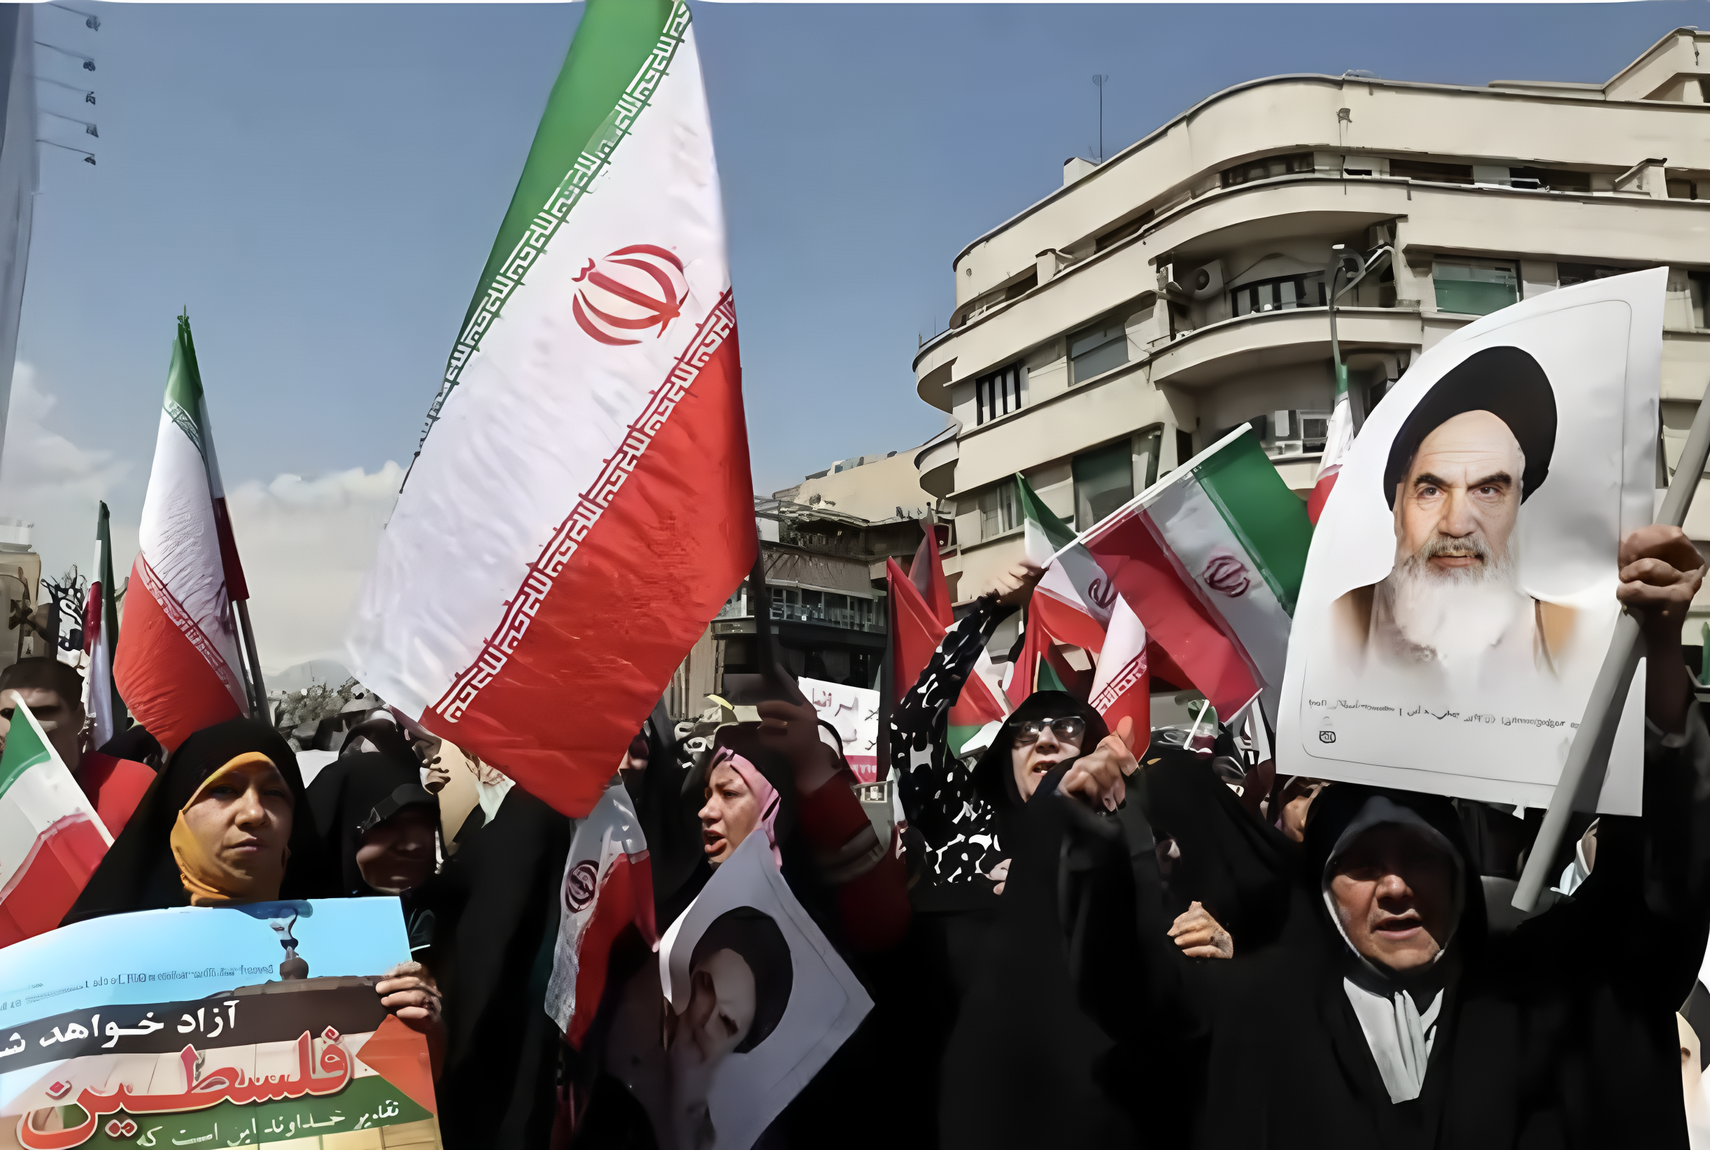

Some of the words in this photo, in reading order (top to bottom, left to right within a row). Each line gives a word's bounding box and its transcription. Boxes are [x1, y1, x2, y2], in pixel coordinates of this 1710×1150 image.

[39, 1012, 164, 1048] خواهد
[177, 999, 239, 1038] آزاد
[16, 1025, 353, 1150] فلسطین
[136, 1126, 163, 1147] که
